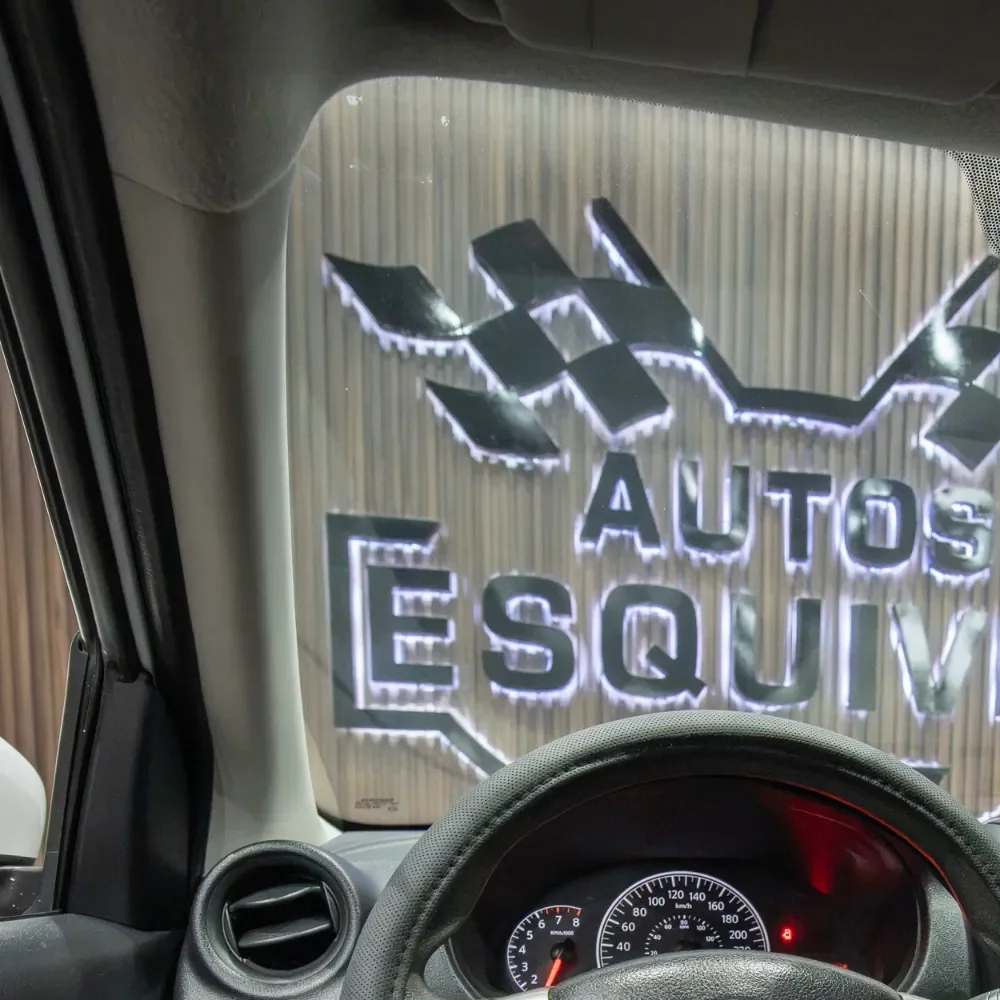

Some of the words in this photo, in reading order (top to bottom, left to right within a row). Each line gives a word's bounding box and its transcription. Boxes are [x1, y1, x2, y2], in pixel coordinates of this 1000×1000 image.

[580, 450, 995, 577] AUTOS
[668, 890, 684, 900] 120
[689, 892, 706, 901] 140
[648, 897, 665, 906] 100
[675, 902, 692, 910] km/h
[708, 901, 724, 911] 160
[633, 907, 647, 917] 80
[538, 919, 546, 929] 6
[555, 915, 562, 925] 7
[572, 917, 580, 927] 8
[722, 914, 739, 924] 180
[621, 922, 636, 932] 60
[526, 930, 533, 940] 5
[729, 930, 747, 940] 200
[518, 944, 526, 954] 4
[616, 942, 631, 951] 40
[521, 962, 528, 972] 3
[531, 974, 538, 984] 2
